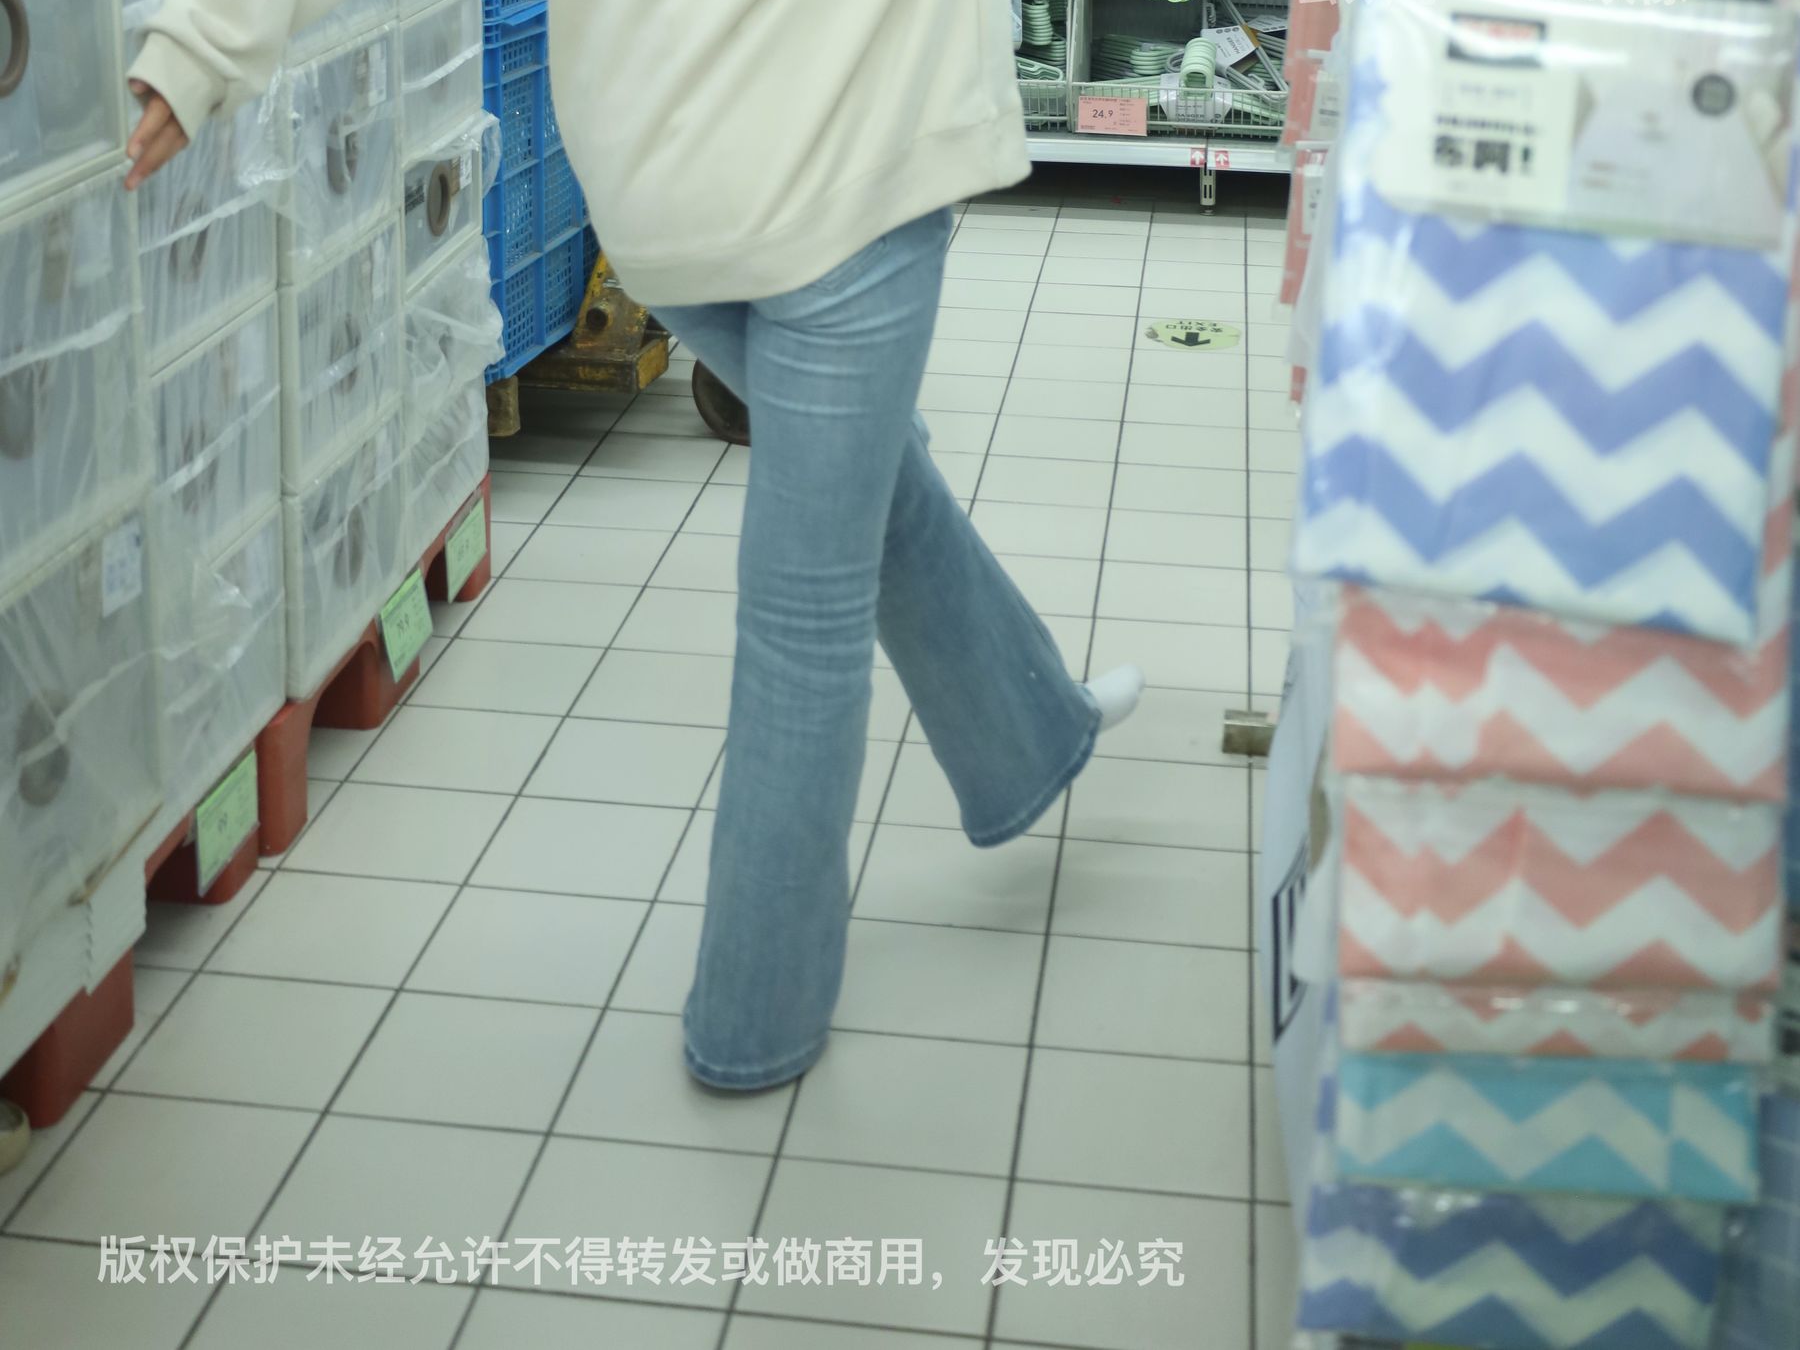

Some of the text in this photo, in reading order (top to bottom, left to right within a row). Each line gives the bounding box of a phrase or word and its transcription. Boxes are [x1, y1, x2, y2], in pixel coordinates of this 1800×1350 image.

[1092, 107, 1115, 119] 24.9
[1166, 324, 1223, 333] 安全出口
